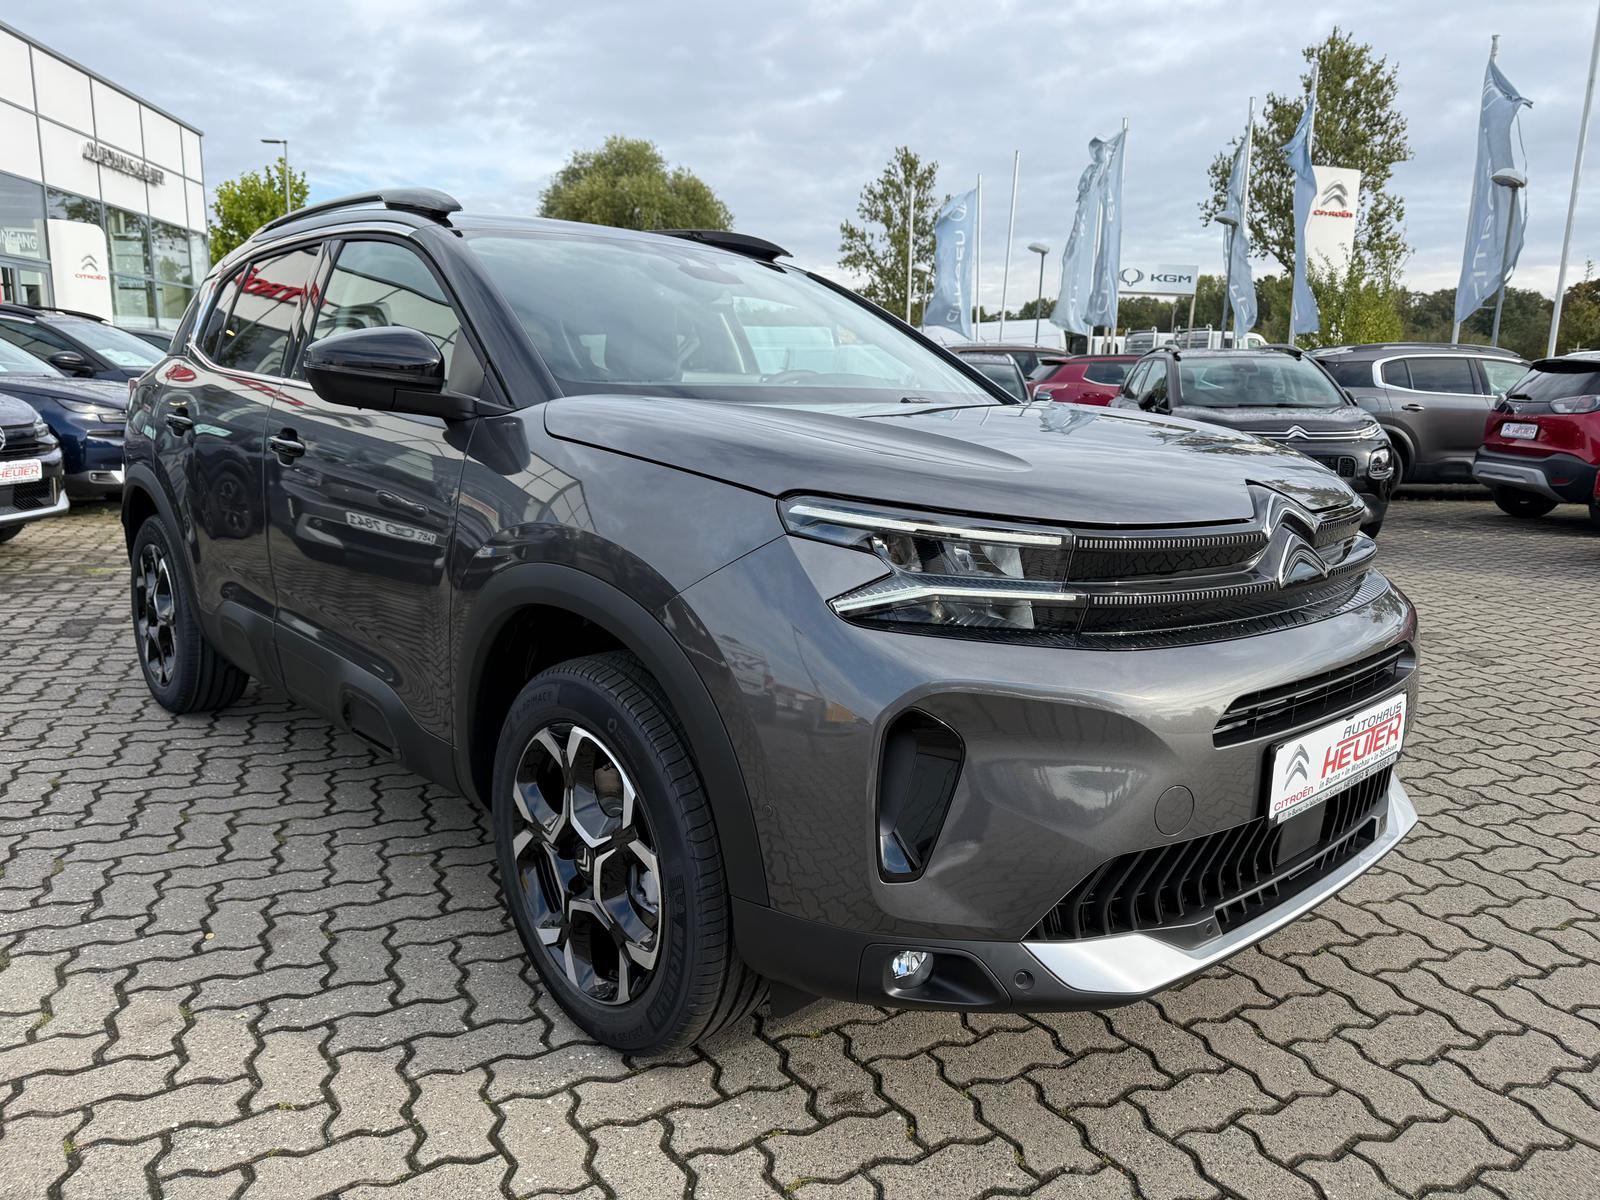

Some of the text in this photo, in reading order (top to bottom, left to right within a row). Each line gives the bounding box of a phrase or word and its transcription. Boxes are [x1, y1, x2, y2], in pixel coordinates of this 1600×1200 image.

[1150, 273, 1192, 284] KGM
[1343, 702, 1403, 739] AUTOHAUS
[1321, 712, 1402, 778] HEUTER
